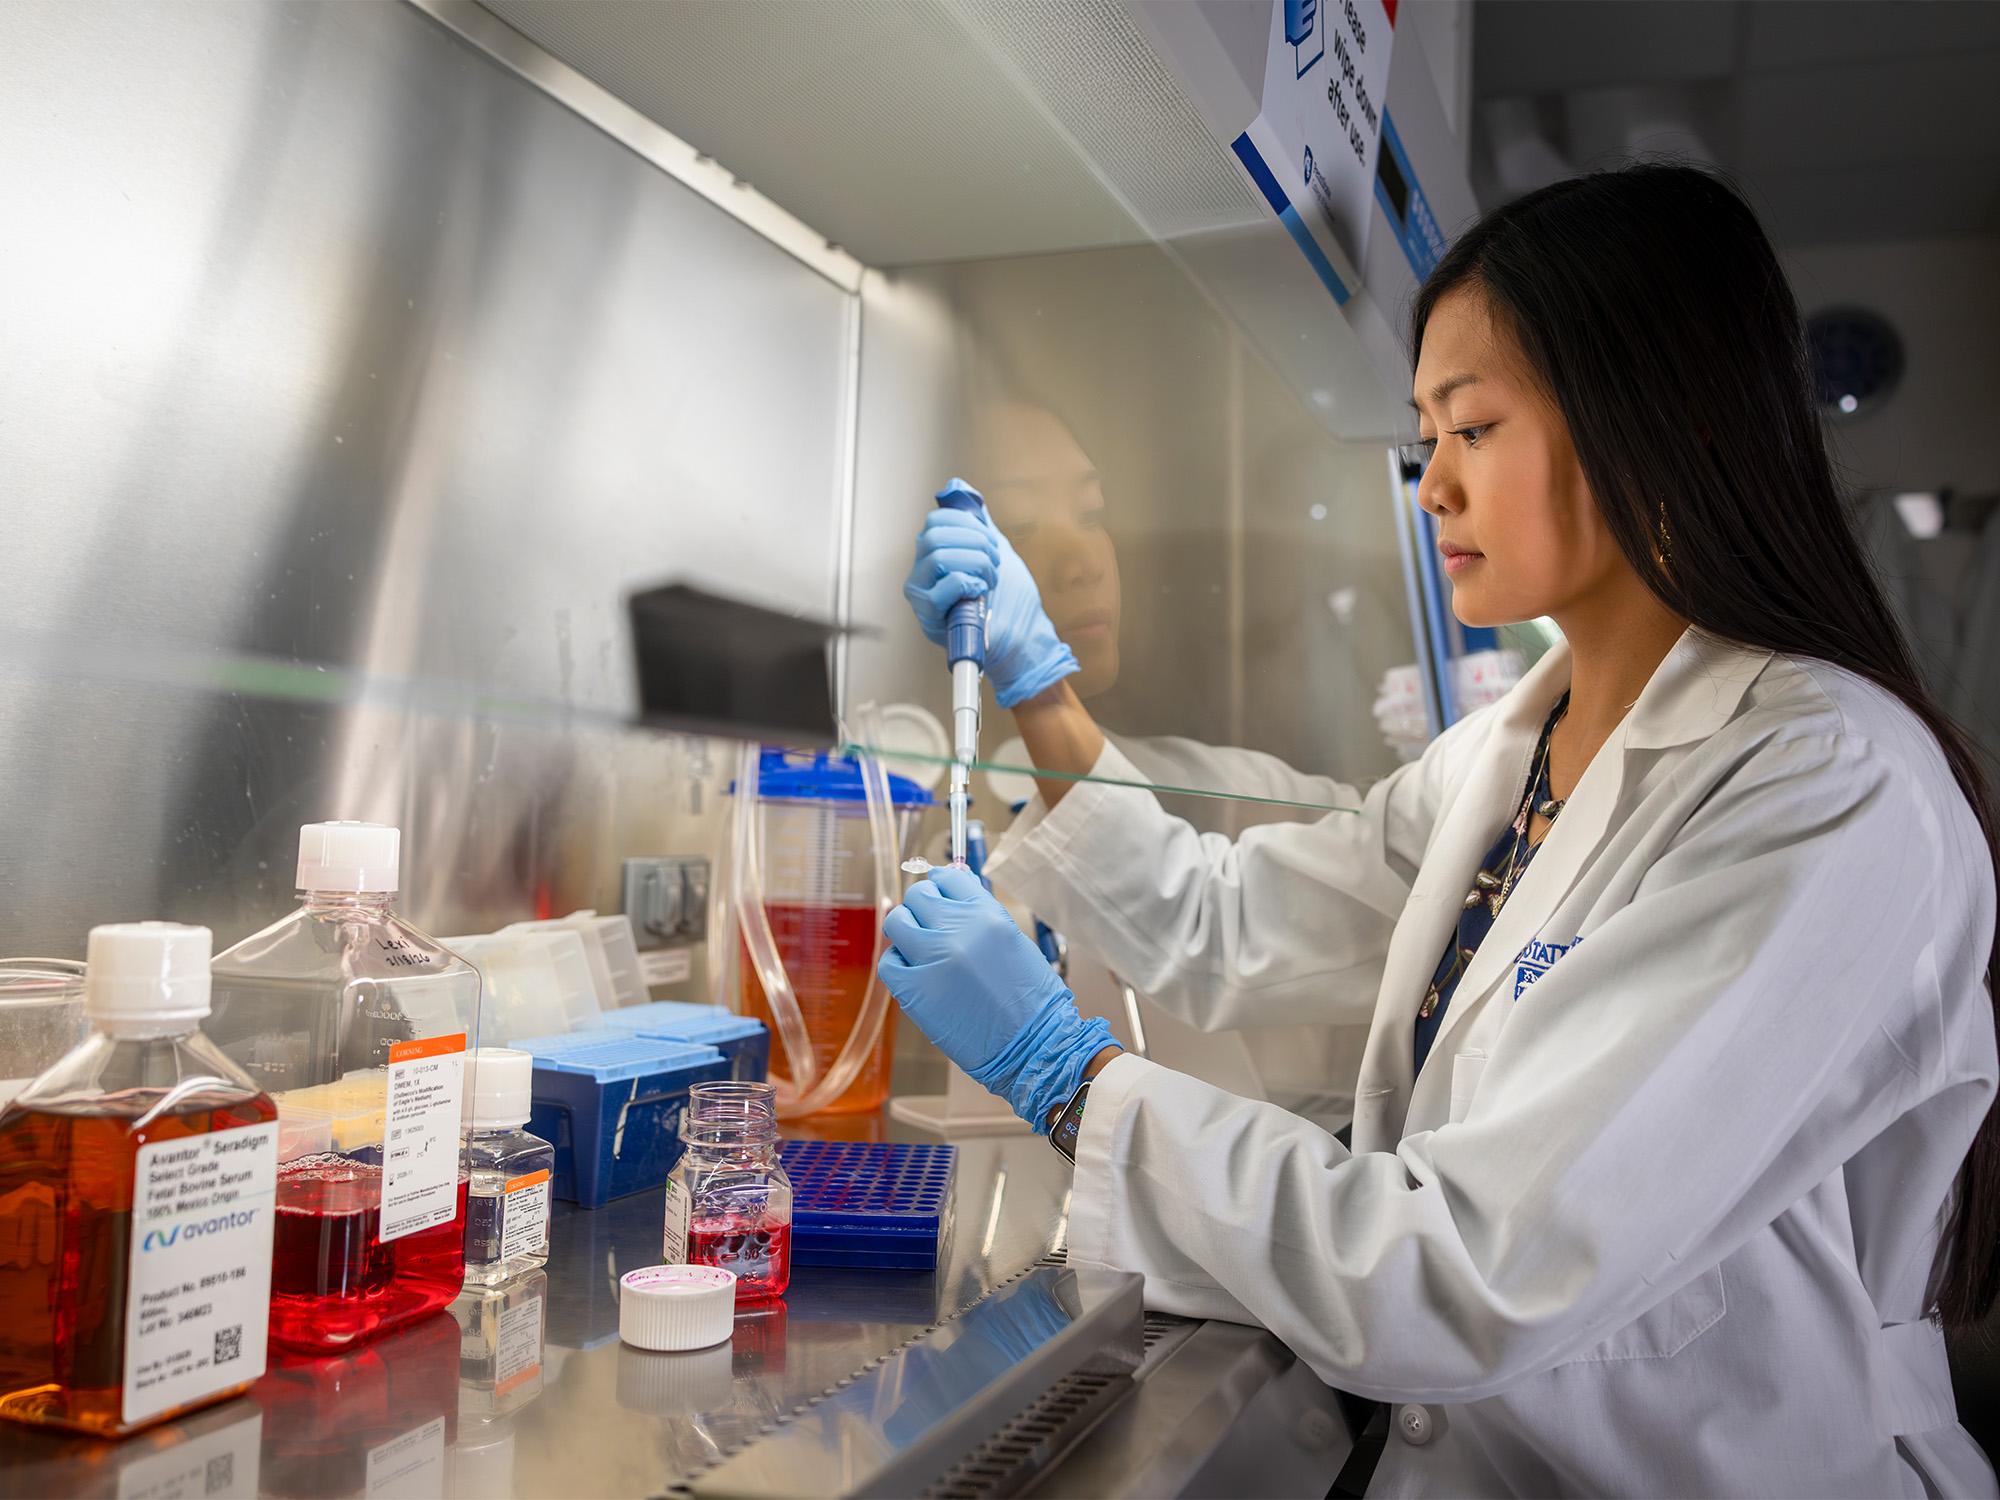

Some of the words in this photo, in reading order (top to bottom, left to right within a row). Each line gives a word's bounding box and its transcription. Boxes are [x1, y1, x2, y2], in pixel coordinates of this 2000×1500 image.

[1339, 0, 1366, 54] lease
[1334, 28, 1355, 88] wipe
[1355, 74, 1378, 136] down
[1328, 78, 1350, 132] after
[376, 937, 410, 950] Lexi
[395, 1047, 423, 1057] CORNING
[214, 1135, 269, 1155] Seradigm
[150, 1167, 185, 1183] Select
[188, 1162, 219, 1175] Grade
[149, 1187, 175, 1201] Fetal
[180, 1180, 216, 1195] Bovine
[220, 1170, 253, 1184] Serum
[176, 1198, 209, 1212] Mexico
[211, 1190, 240, 1205] Origin
[183, 1209, 256, 1240] avantor
[142, 1287, 180, 1304] Product
